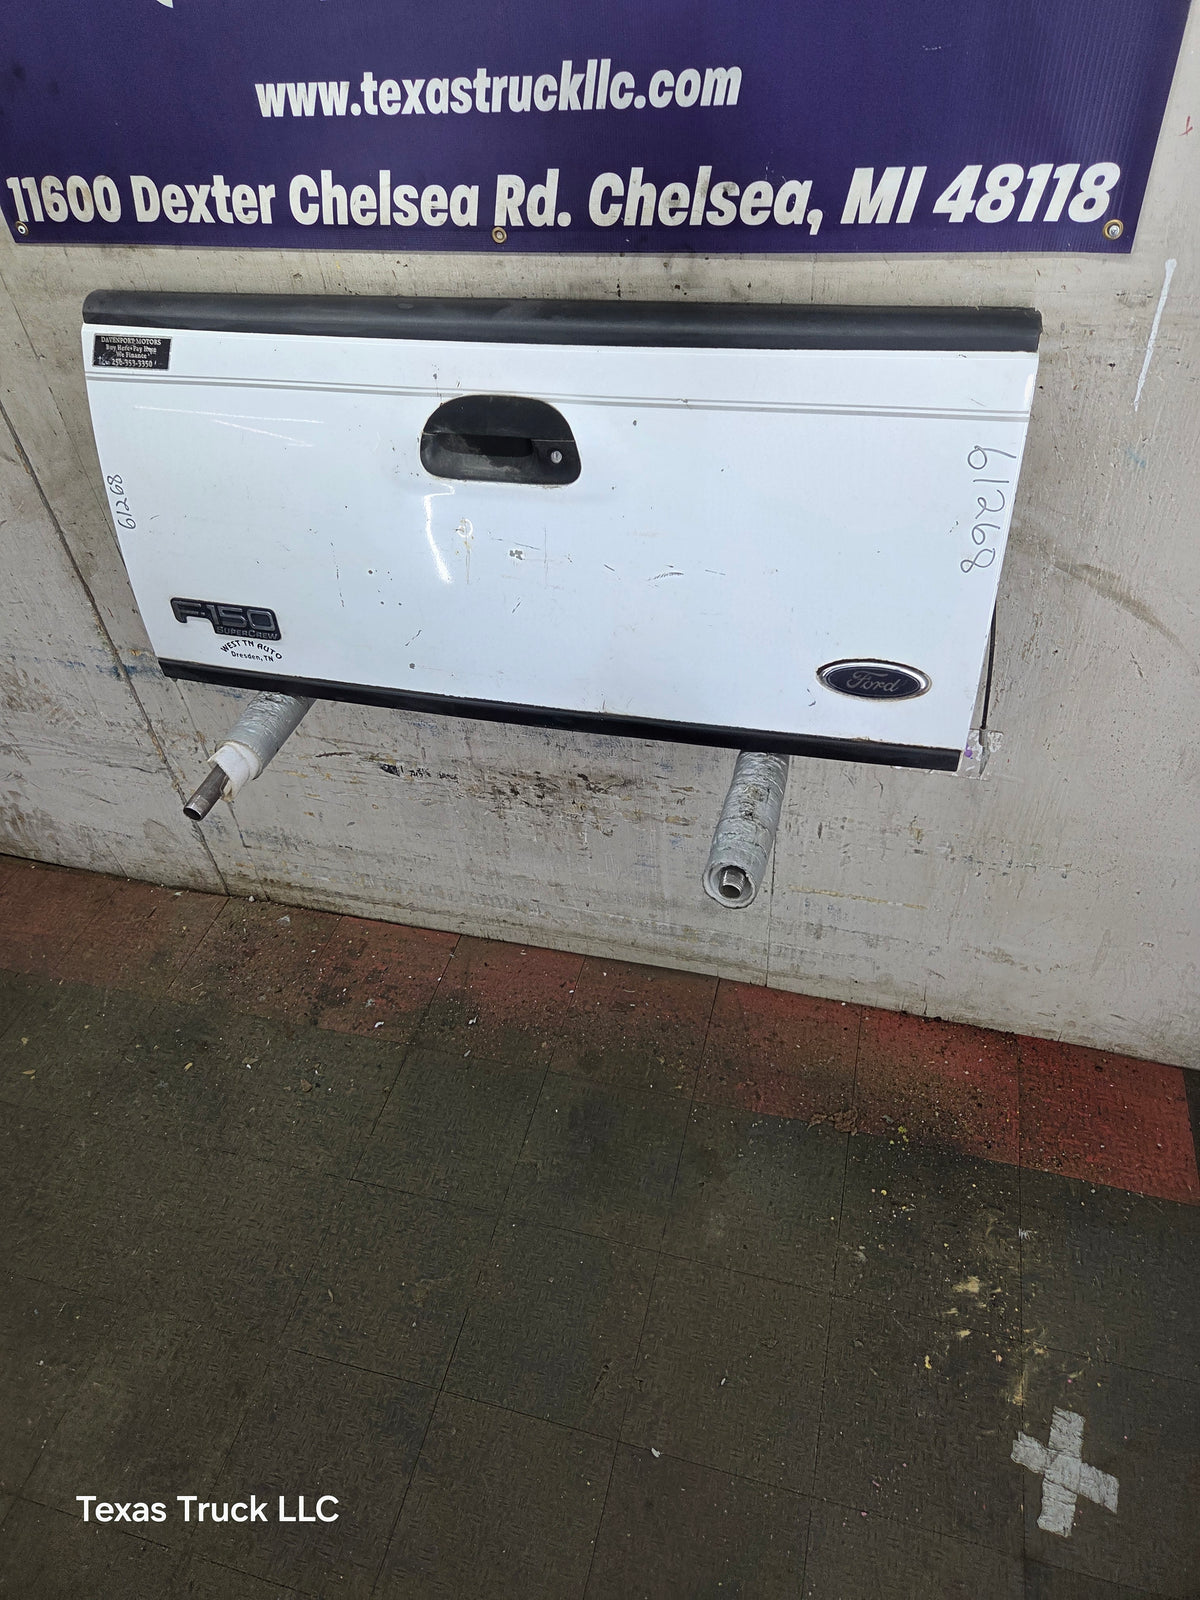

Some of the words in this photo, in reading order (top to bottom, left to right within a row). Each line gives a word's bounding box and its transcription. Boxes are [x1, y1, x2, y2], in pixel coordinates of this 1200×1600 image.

[254, 58, 742, 118] www.texastruckllc.com
[6, 173, 121, 224] 11600
[129, 174, 276, 225] Dexter
[288, 168, 480, 228] Chelsea
[494, 168, 572, 228] Rd.
[588, 165, 825, 236] Chelsea,
[840, 164, 928, 225] MI
[932, 161, 1121, 224] 48118
[135, 338, 162, 346] MOTORS
[106, 474, 136, 530] 61268
[960, 445, 1017, 573] 61268
[220, 639, 241, 653] WEST
[242, 639, 255, 648] TN
[257, 643, 283, 660] AUTO
[230, 650, 263, 661] Dresden,
[846, 670, 901, 693] Ford
